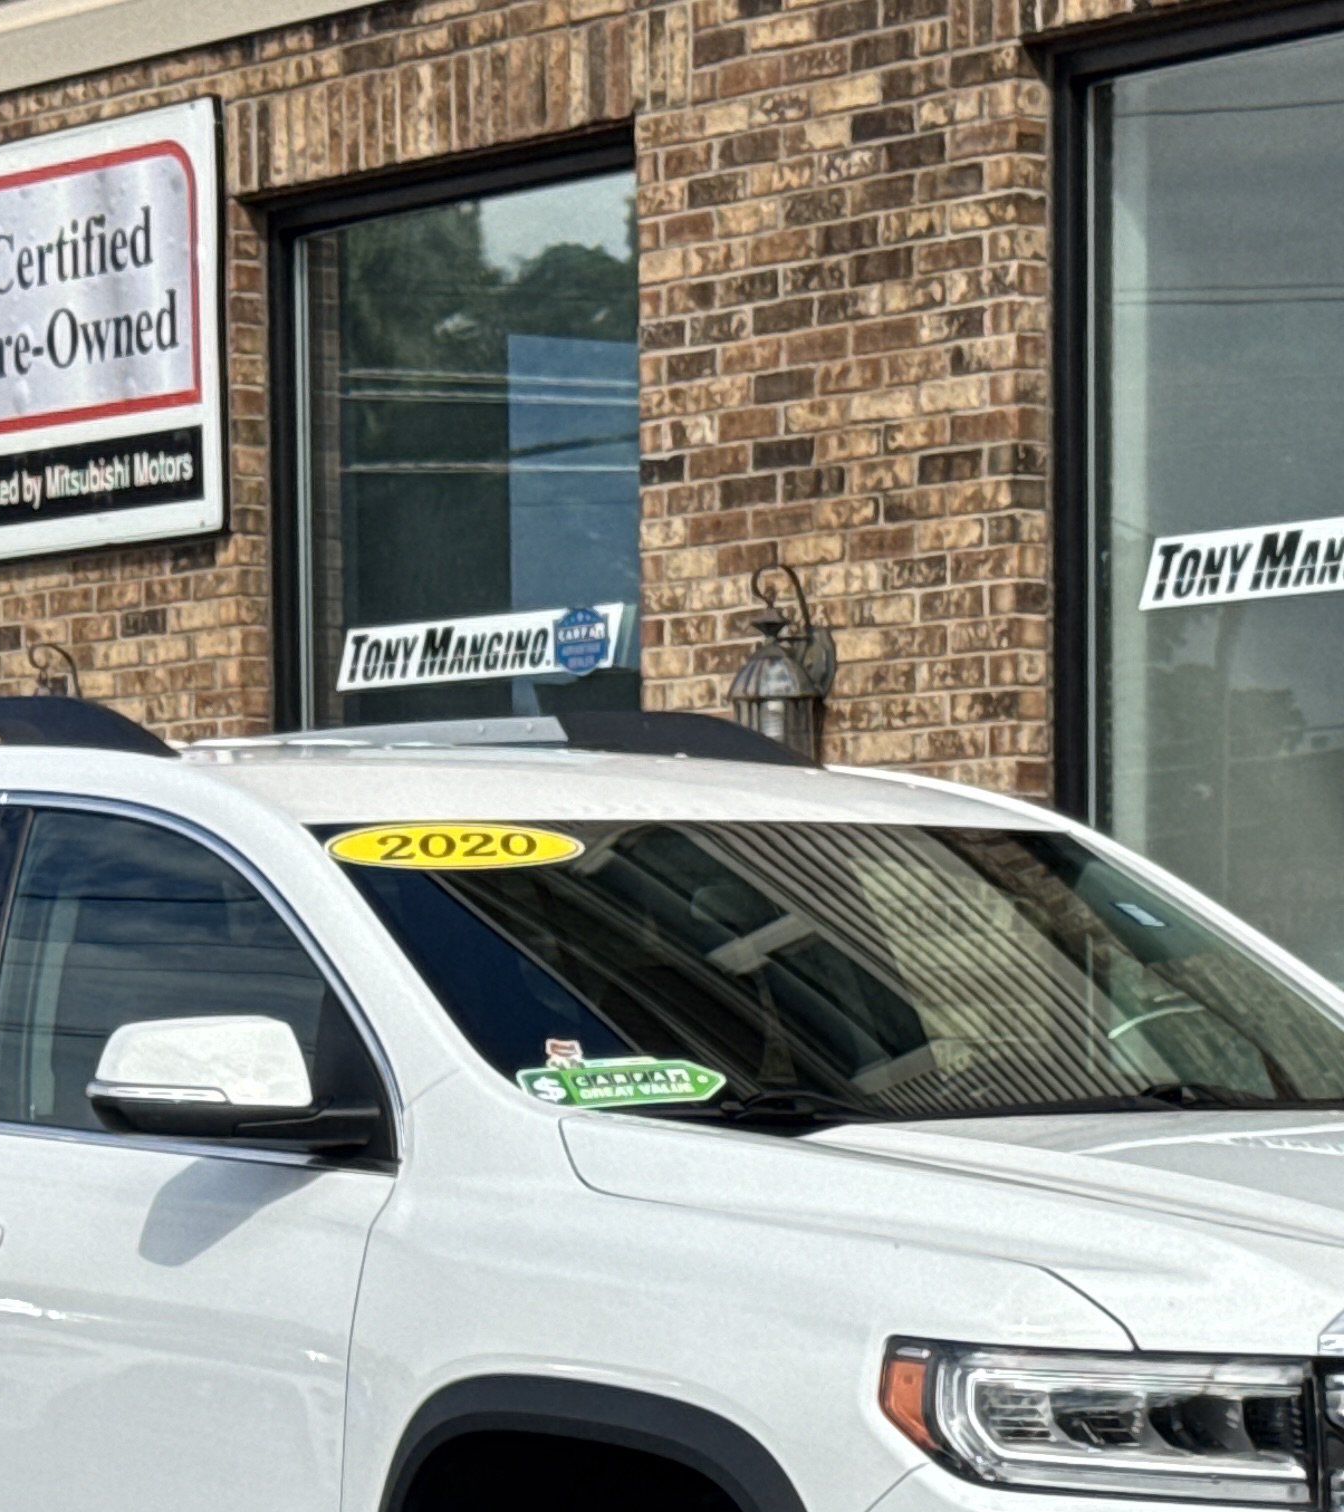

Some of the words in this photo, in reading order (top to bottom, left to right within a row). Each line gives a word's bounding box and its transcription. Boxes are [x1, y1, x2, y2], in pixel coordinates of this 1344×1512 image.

[21, 469, 43, 510] by
[44, 453, 131, 500] Mitsubishi
[132, 450, 194, 487] Motors
[376, 833, 537, 861] 2020
